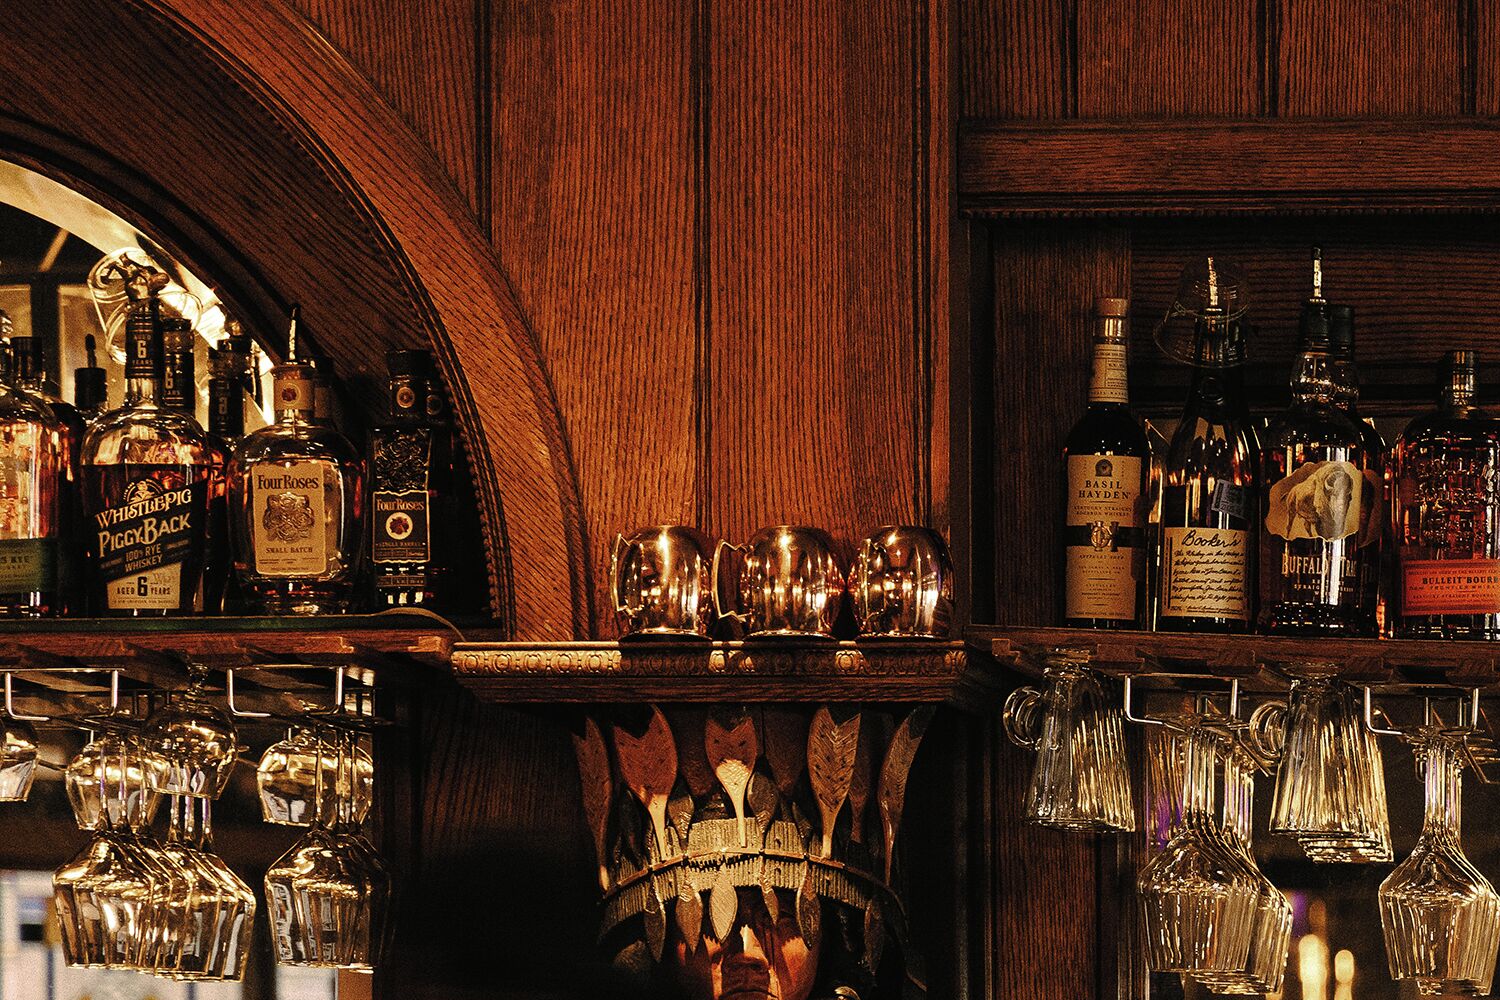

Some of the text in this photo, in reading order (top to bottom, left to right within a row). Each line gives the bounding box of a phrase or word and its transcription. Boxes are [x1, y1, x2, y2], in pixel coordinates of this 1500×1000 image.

[137, 340, 147, 359] 6
[257, 475, 320, 490] Four Roses
[1085, 480, 1123, 489] BASIL
[95, 489, 192, 529] WHISTLEPIG
[376, 499, 425, 511] Four Roses
[98, 512, 192, 558] PIGGYBACK
[1182, 530, 1241, 548] Booker's
[145, 543, 162, 557] RYE
[125, 555, 163, 572] WHISKEY
[117, 576, 171, 597] AGED 6 YEARS
[1422, 575, 1463, 585] BULLEIT
